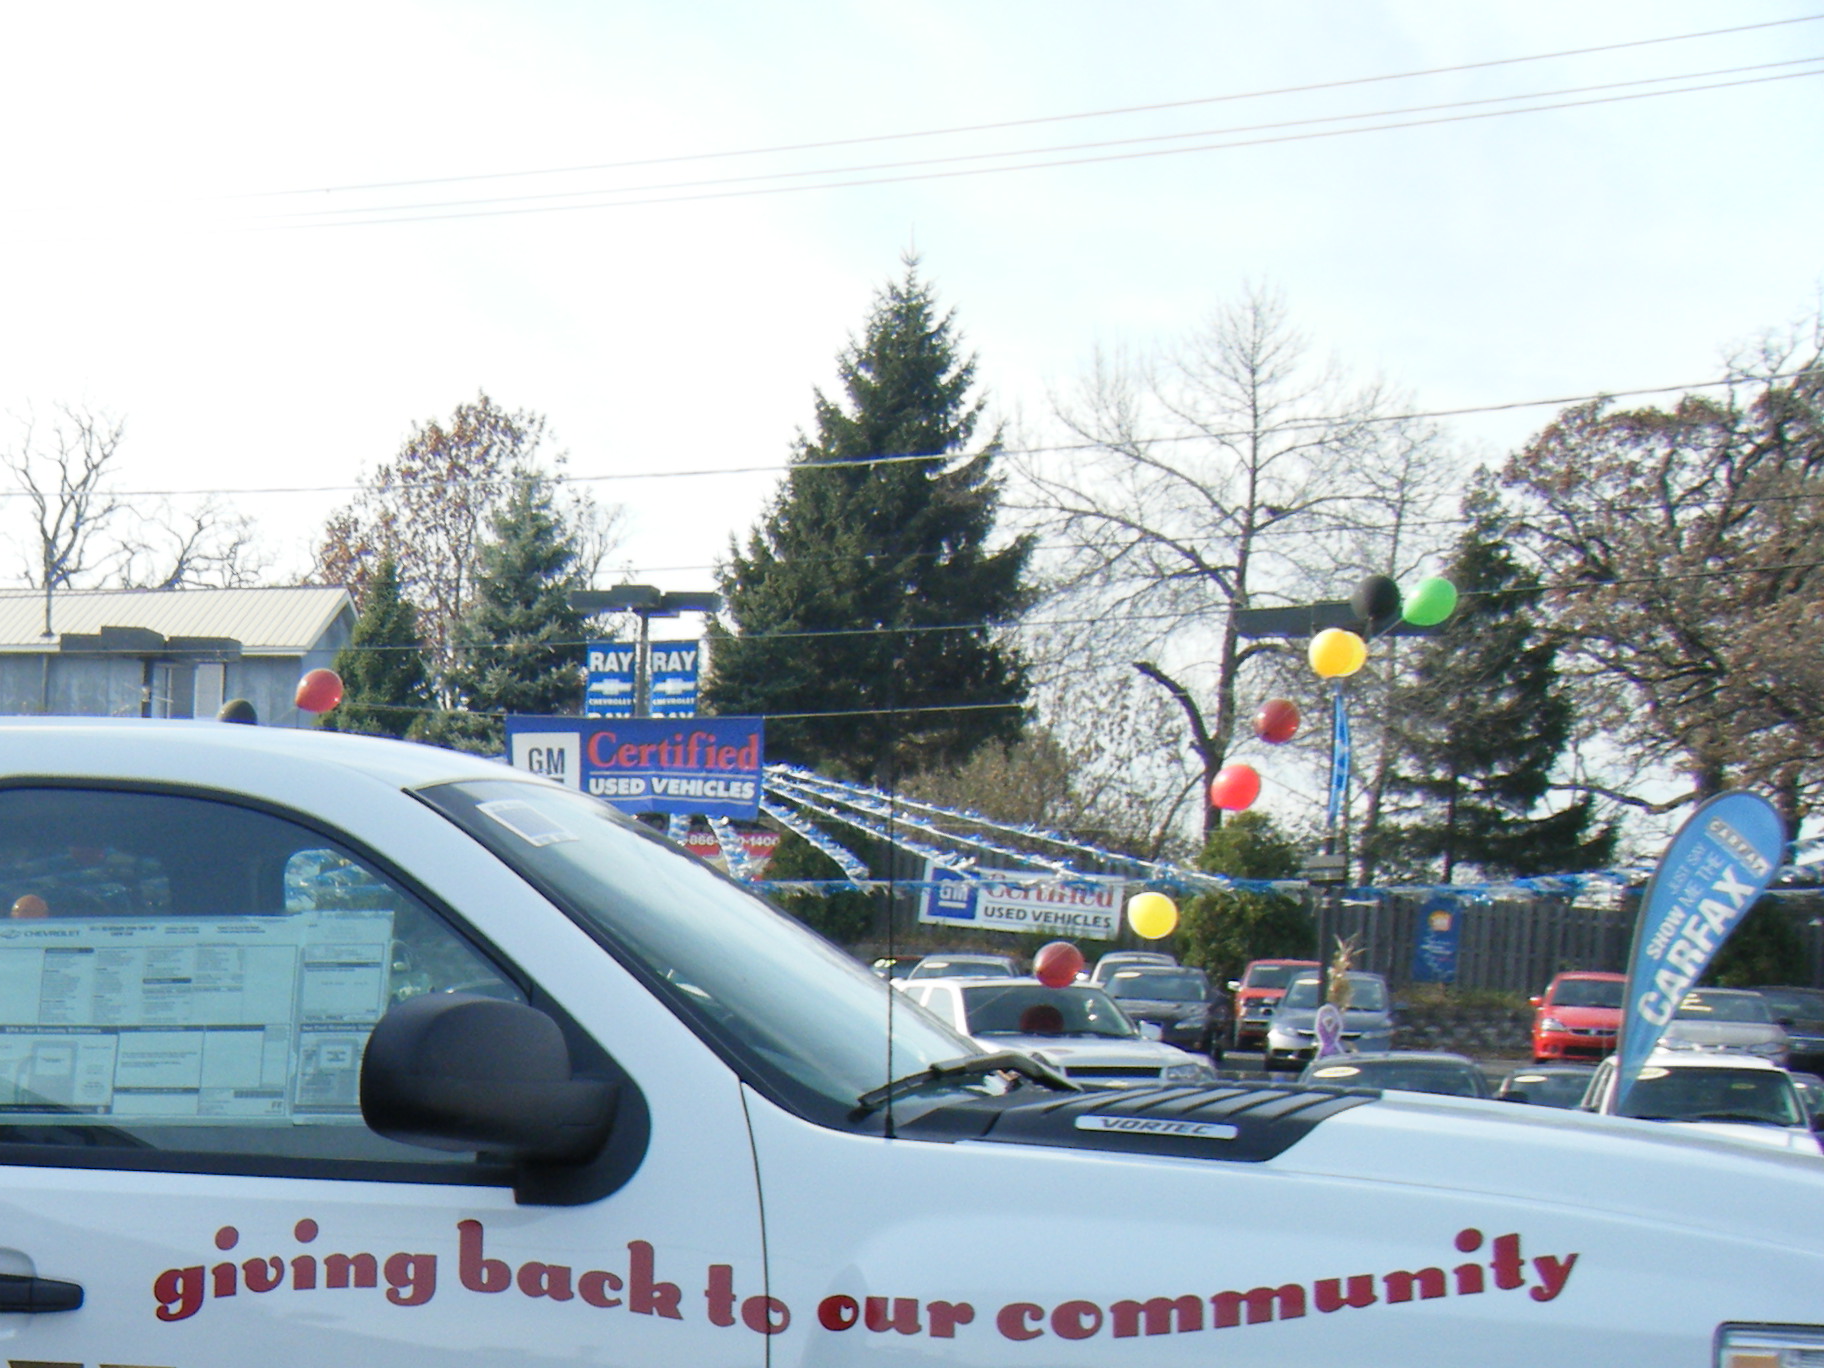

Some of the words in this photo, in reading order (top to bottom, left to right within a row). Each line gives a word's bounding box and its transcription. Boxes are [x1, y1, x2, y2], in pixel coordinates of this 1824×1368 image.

[589, 651, 634, 672] RAY
[652, 651, 696, 672] RAY
[528, 747, 565, 775] GM
[587, 731, 759, 771] Certified
[589, 777, 646, 796] USED
[651, 777, 755, 799] VEHICLES
[984, 905, 1026, 921] USED
[1033, 909, 1112, 929] VEHICLES
[1646, 904, 1687, 961] SHOW
[1678, 879, 1706, 908] ME
[1695, 851, 1727, 882] THE
[1637, 864, 1758, 1027] CARFAX
[1102, 1118, 1216, 1135] VORTEC
[153, 1218, 437, 1323] giving
[457, 1219, 684, 1321] back
[705, 1264, 791, 1335] to
[817, 1294, 975, 1338] our
[996, 1227, 1580, 1341] community
